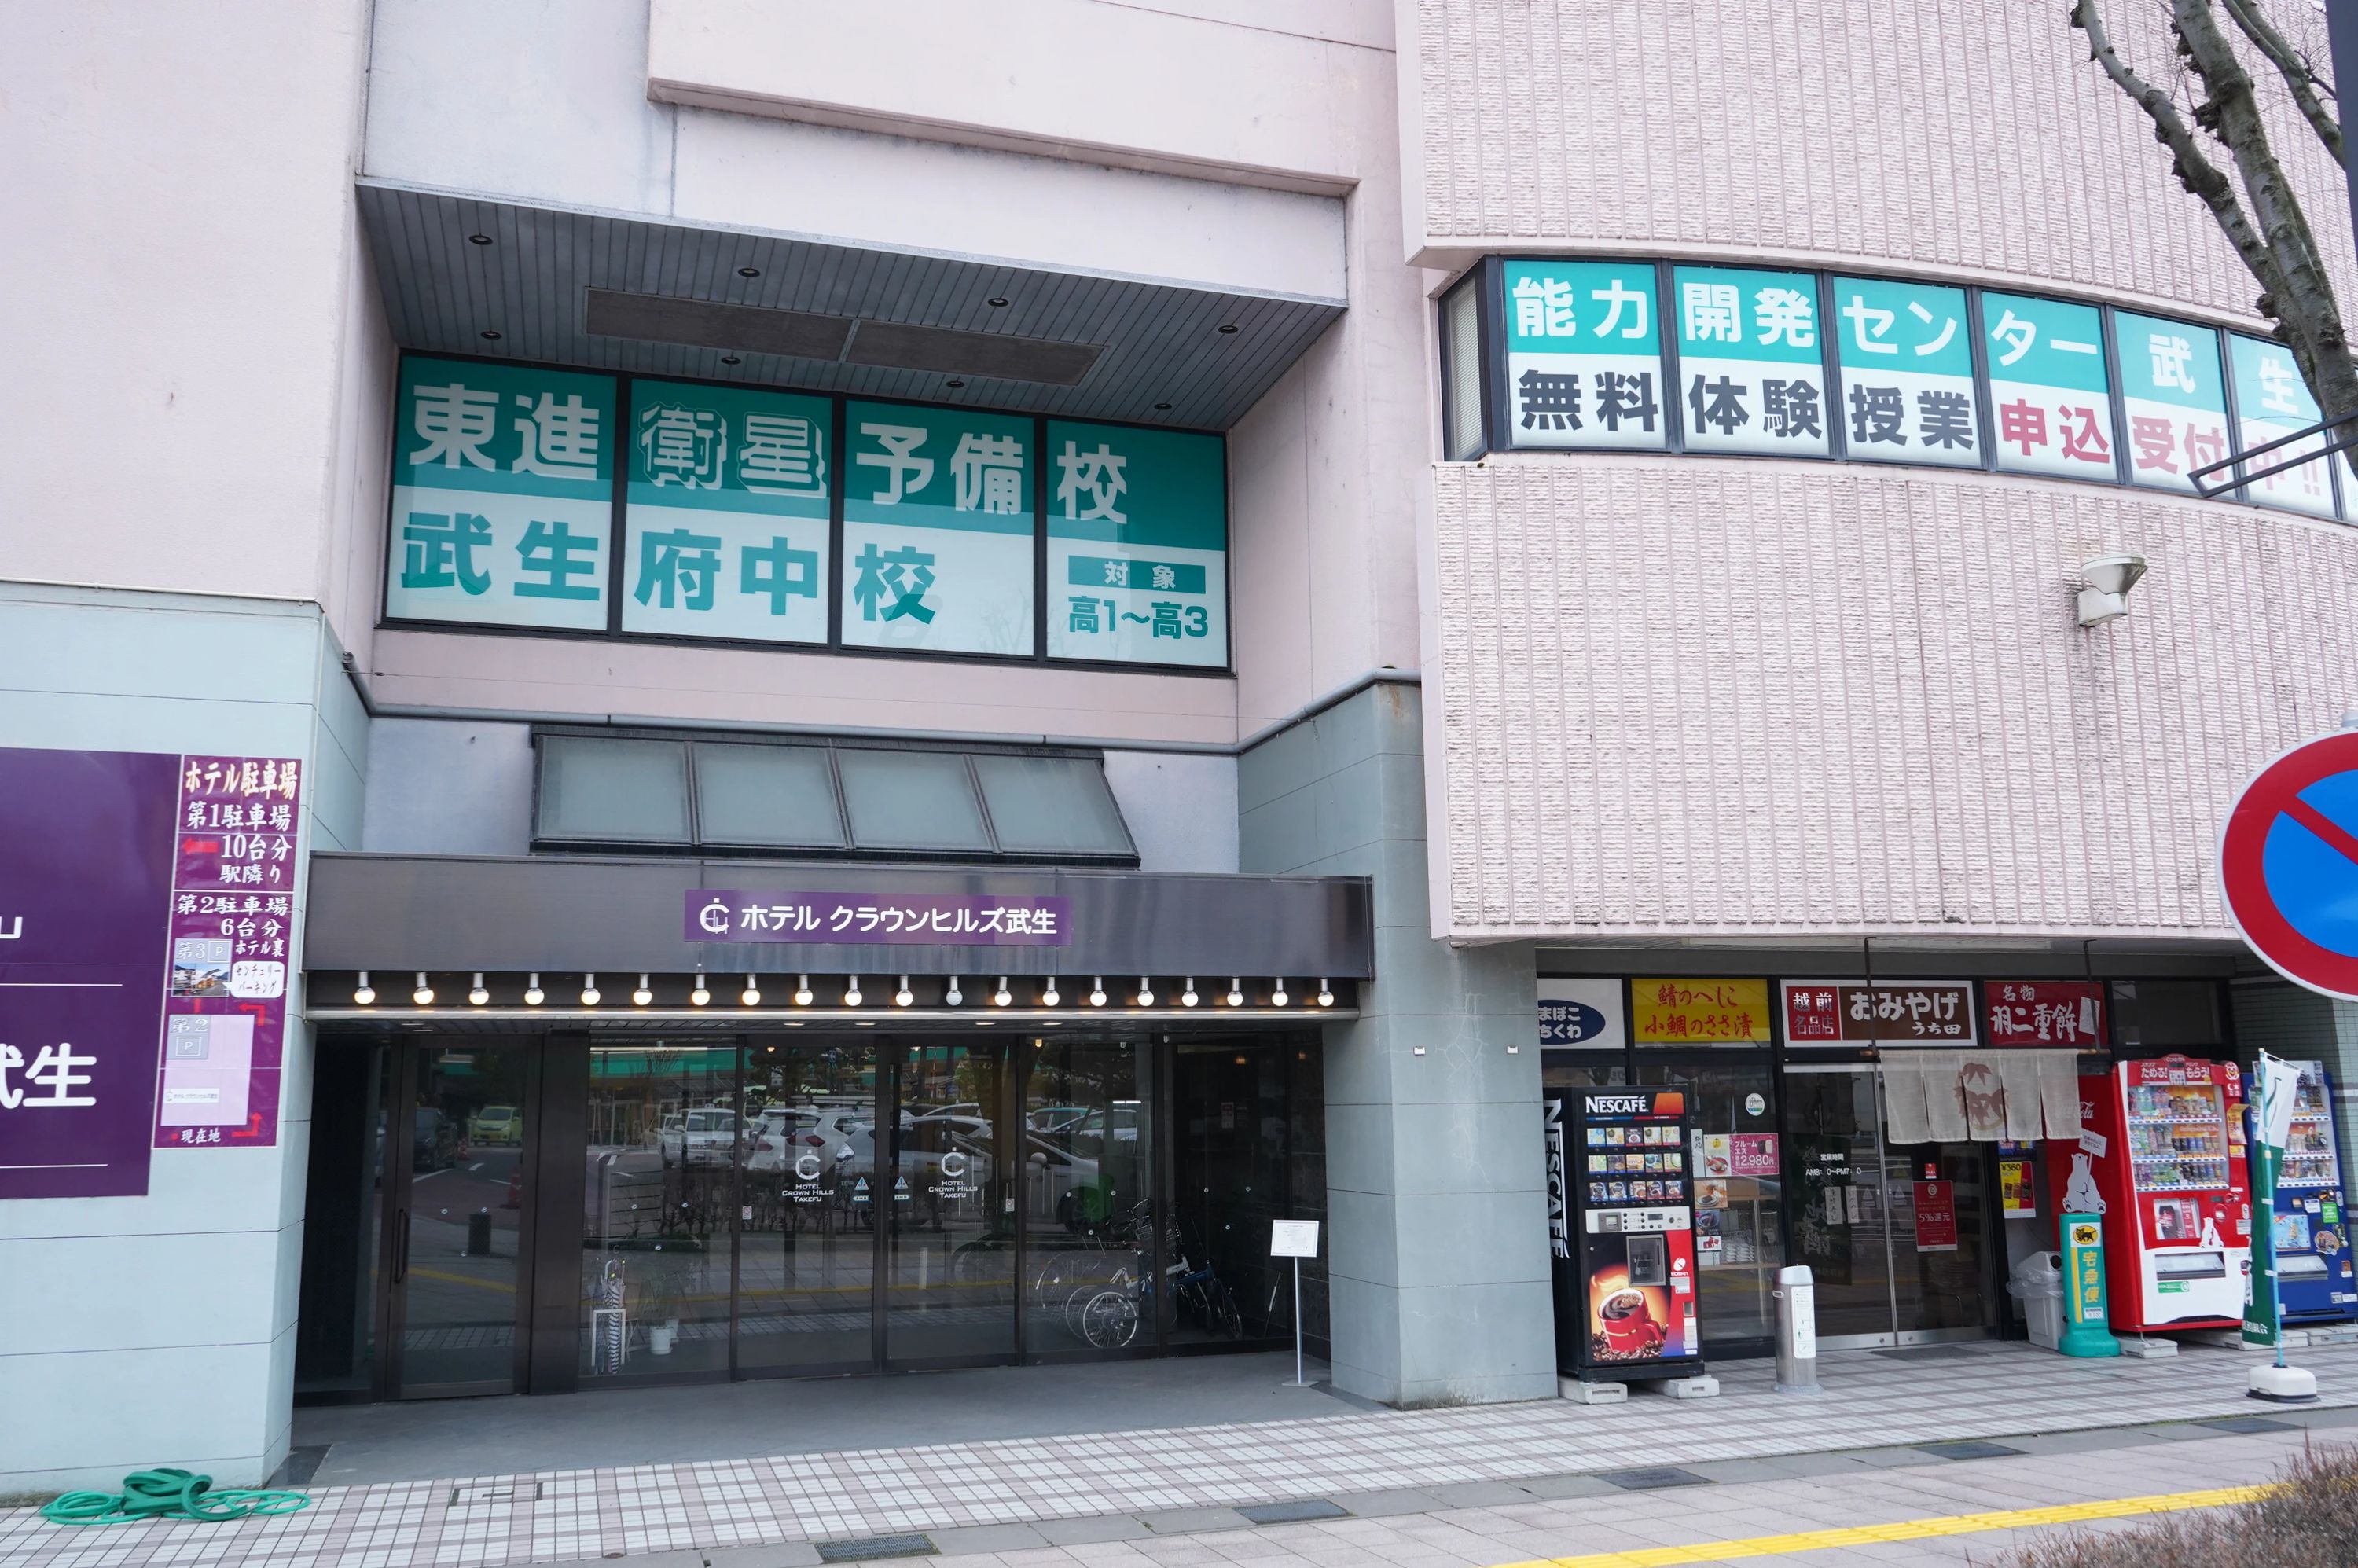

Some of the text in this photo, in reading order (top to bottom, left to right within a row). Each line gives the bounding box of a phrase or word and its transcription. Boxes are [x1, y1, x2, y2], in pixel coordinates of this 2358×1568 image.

[399, 512, 936, 625] 武生府中校
[185, 759, 298, 800] ホテル駐車場
[186, 800, 292, 832] 第1駐車場
[221, 833, 293, 861] 10台分
[219, 864, 281, 885] 駅隣り
[176, 894, 290, 916] 第2駐車場
[220, 917, 285, 938] 6台分
[740, 905, 1058, 935] ホテル クラウンヒルズ武生
[235, 938, 285, 957] ホテル裏
[1793, 992, 1833, 1012] 越前
[2003, 984, 2035, 1001] 名物
[1849, 991, 1959, 1022] おみやげ
[1794, 1015, 1835, 1036] 名品店
[1912, 1021, 1962, 1036] うち田
[1989, 1001, 2077, 1043] 羽二重餅
[1585, 1095, 1647, 1114] NESCAFÉ
[181, 1127, 222, 1144] 現在地
